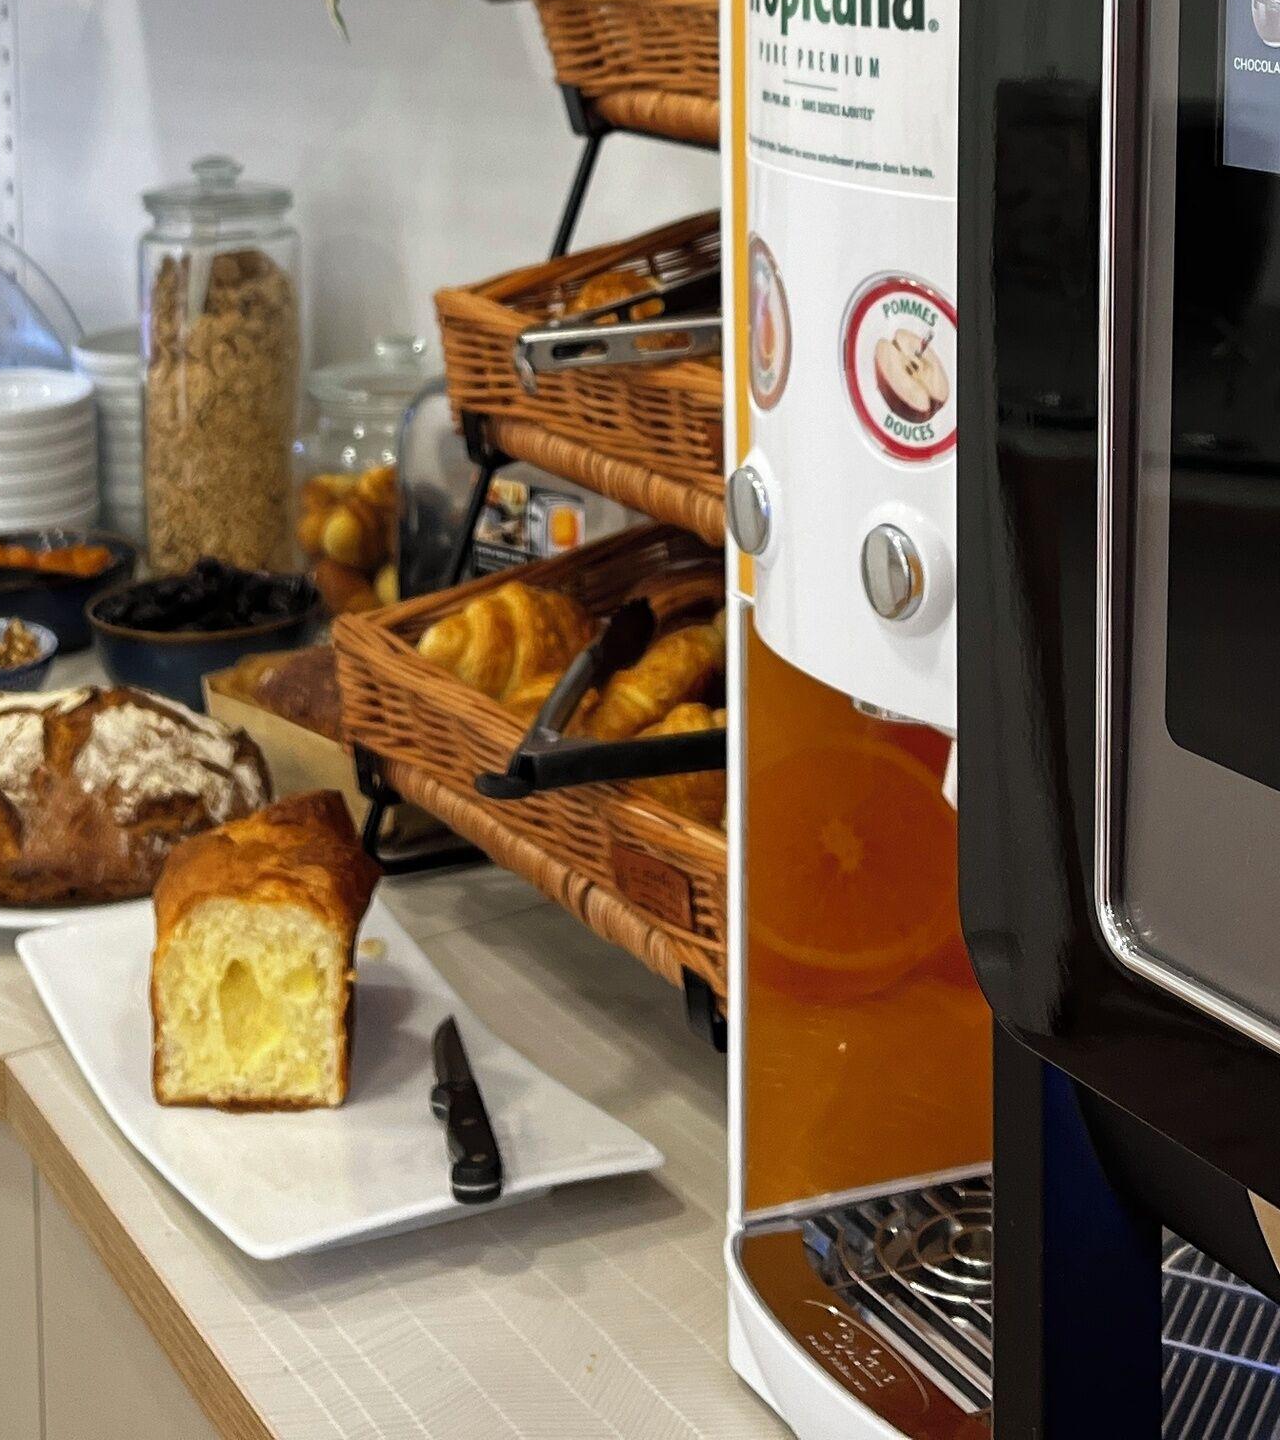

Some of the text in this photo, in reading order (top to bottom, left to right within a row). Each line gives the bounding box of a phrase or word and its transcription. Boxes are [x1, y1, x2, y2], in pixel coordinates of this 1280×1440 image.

[797, 44, 880, 79] PREMIUM
[882, 298, 939, 328] POMMES
[884, 414, 935, 441] DOUCES
